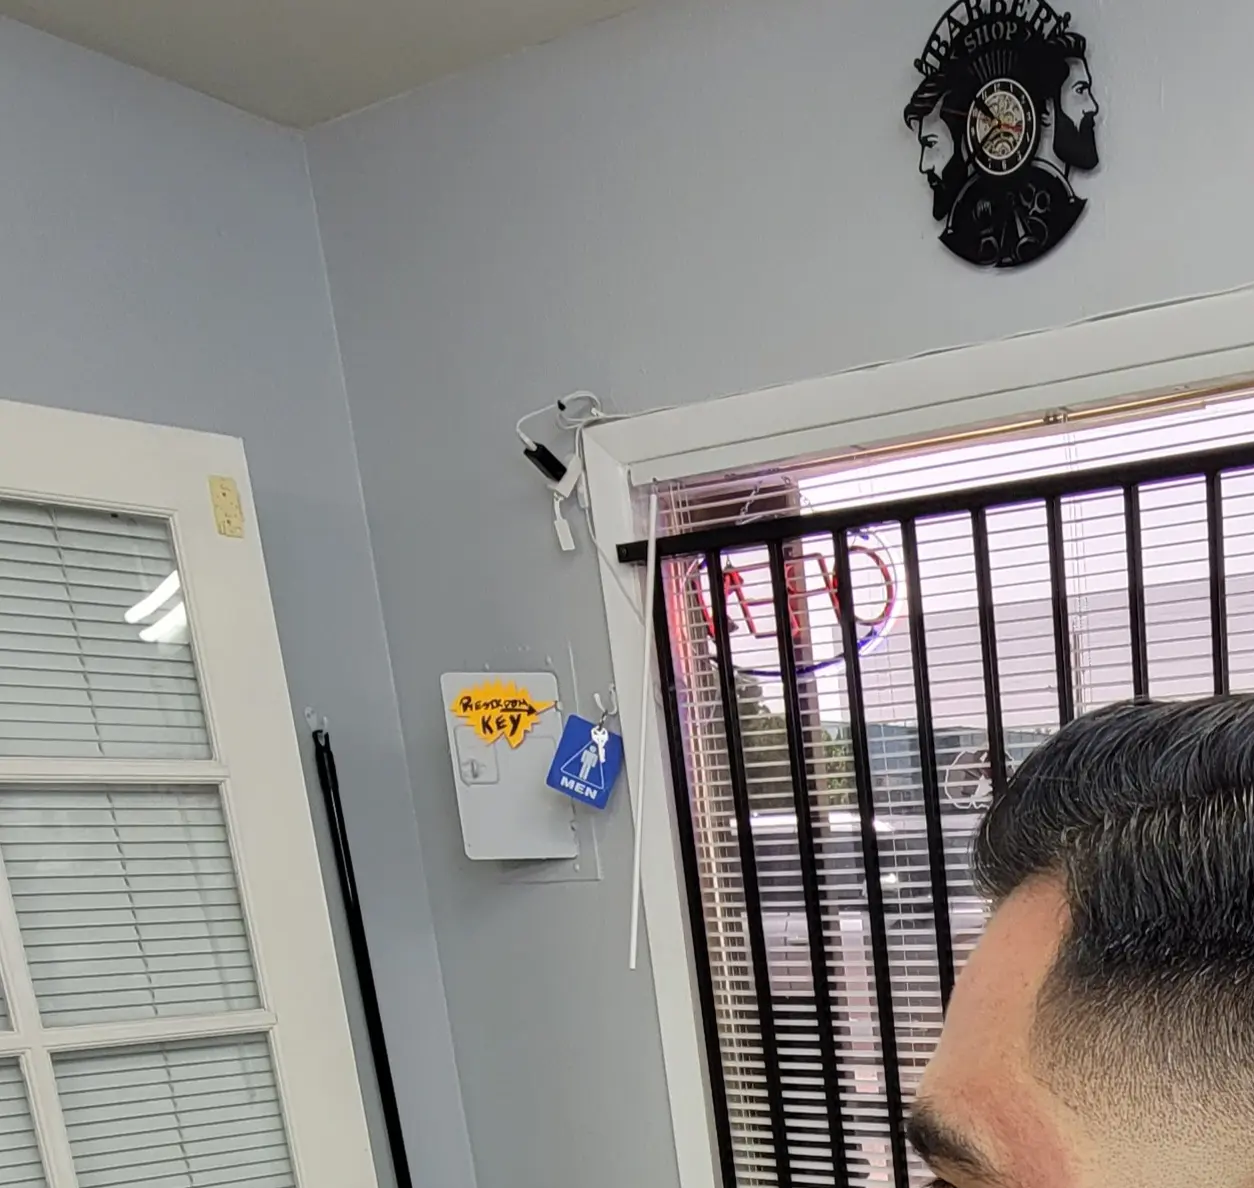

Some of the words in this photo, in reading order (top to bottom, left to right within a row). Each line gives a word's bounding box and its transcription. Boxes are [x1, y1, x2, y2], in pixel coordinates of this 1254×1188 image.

[964, 20, 1018, 53] SHOP
[481, 713, 522, 737] KEY
[560, 776, 598, 800] MEN
